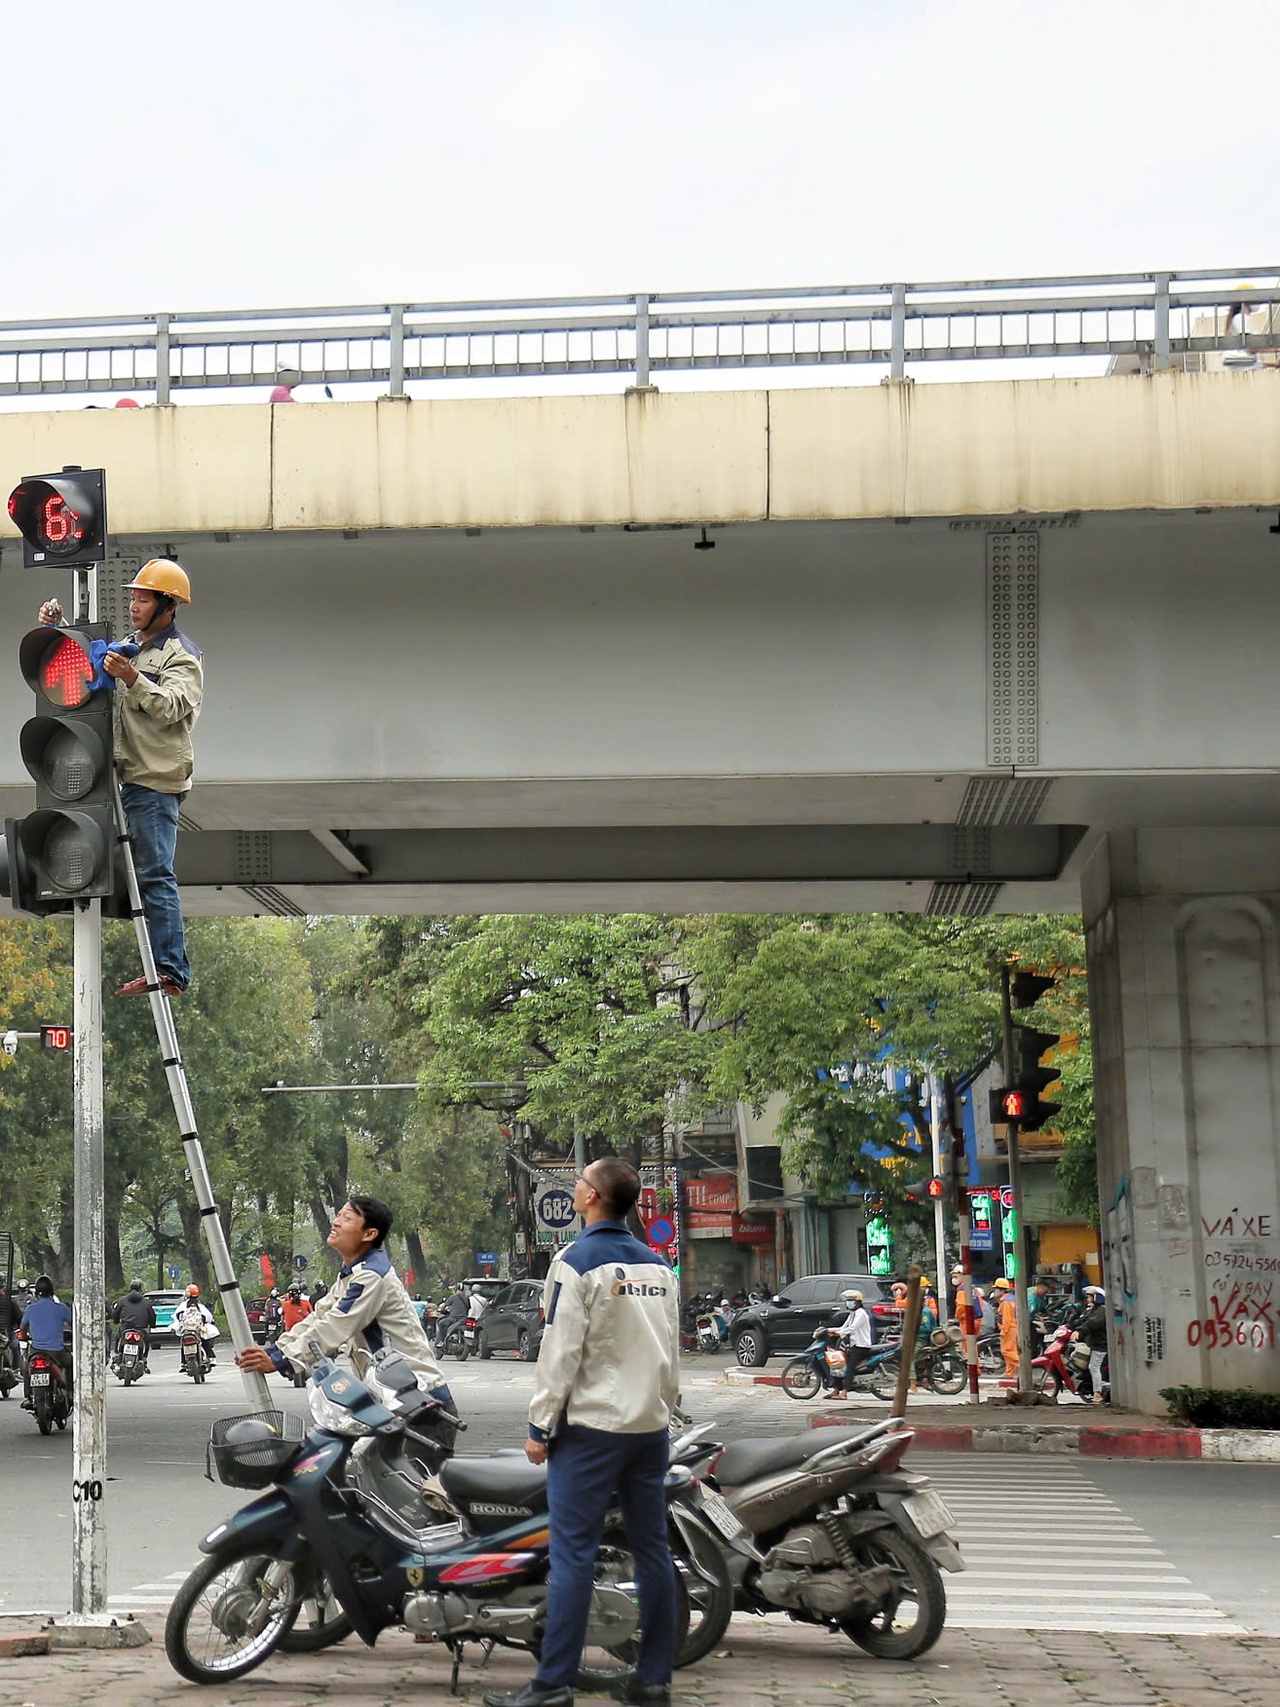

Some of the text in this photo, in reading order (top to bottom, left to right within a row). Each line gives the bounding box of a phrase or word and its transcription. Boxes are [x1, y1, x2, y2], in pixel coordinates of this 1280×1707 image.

[47, 1029, 68, 1049] 70
[542, 1198, 573, 1221] 682
[739, 1224, 767, 1233] blum
[1201, 1207, 1271, 1237] VÁ XE
[72, 1480, 103, 1503] C10
[471, 1503, 531, 1515] HONDA
